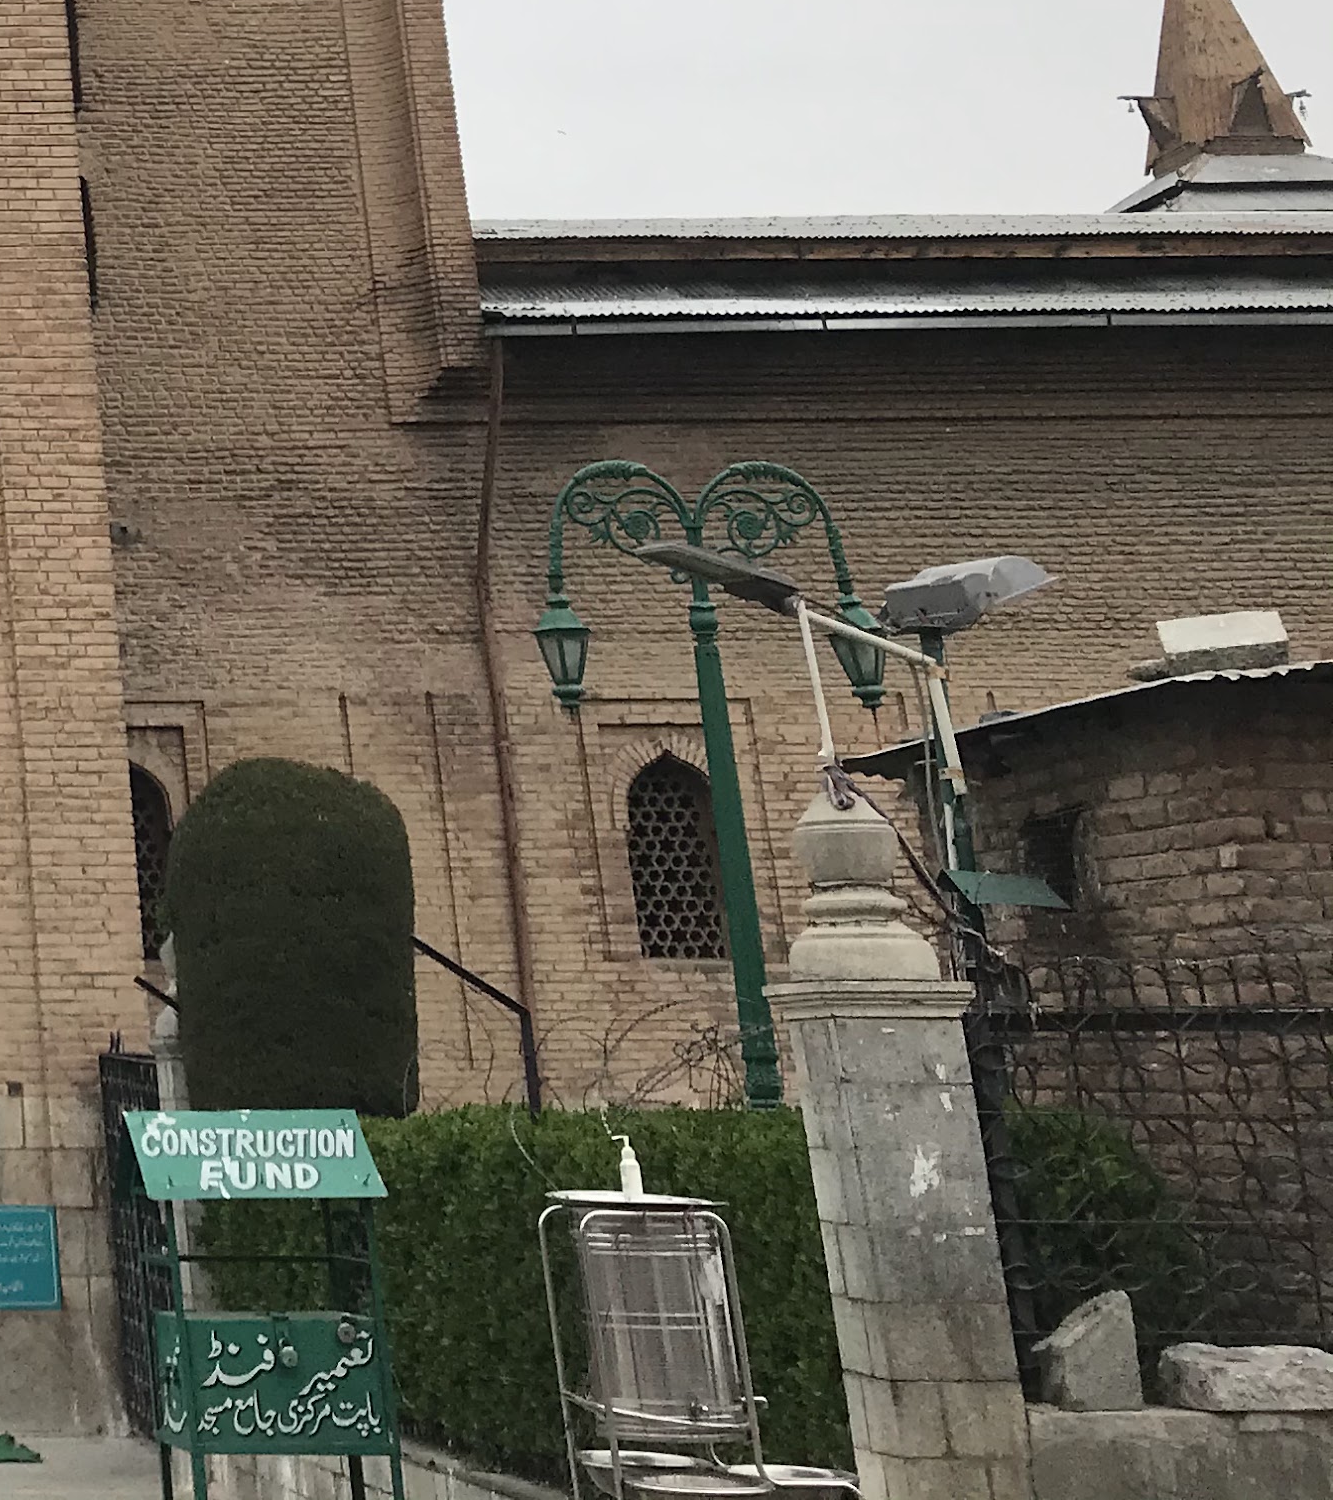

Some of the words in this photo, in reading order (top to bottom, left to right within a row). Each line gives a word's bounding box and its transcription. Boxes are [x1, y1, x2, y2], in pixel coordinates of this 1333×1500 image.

[140, 1128, 356, 1159] CONSTRUCTION
[200, 1160, 320, 1192] FUND
[200, 1329, 275, 1388] فنڈ
[197, 1396, 233, 1435] مسجد
[234, 1389, 277, 1437] جامع
[277, 1393, 331, 1435] مرکزی
